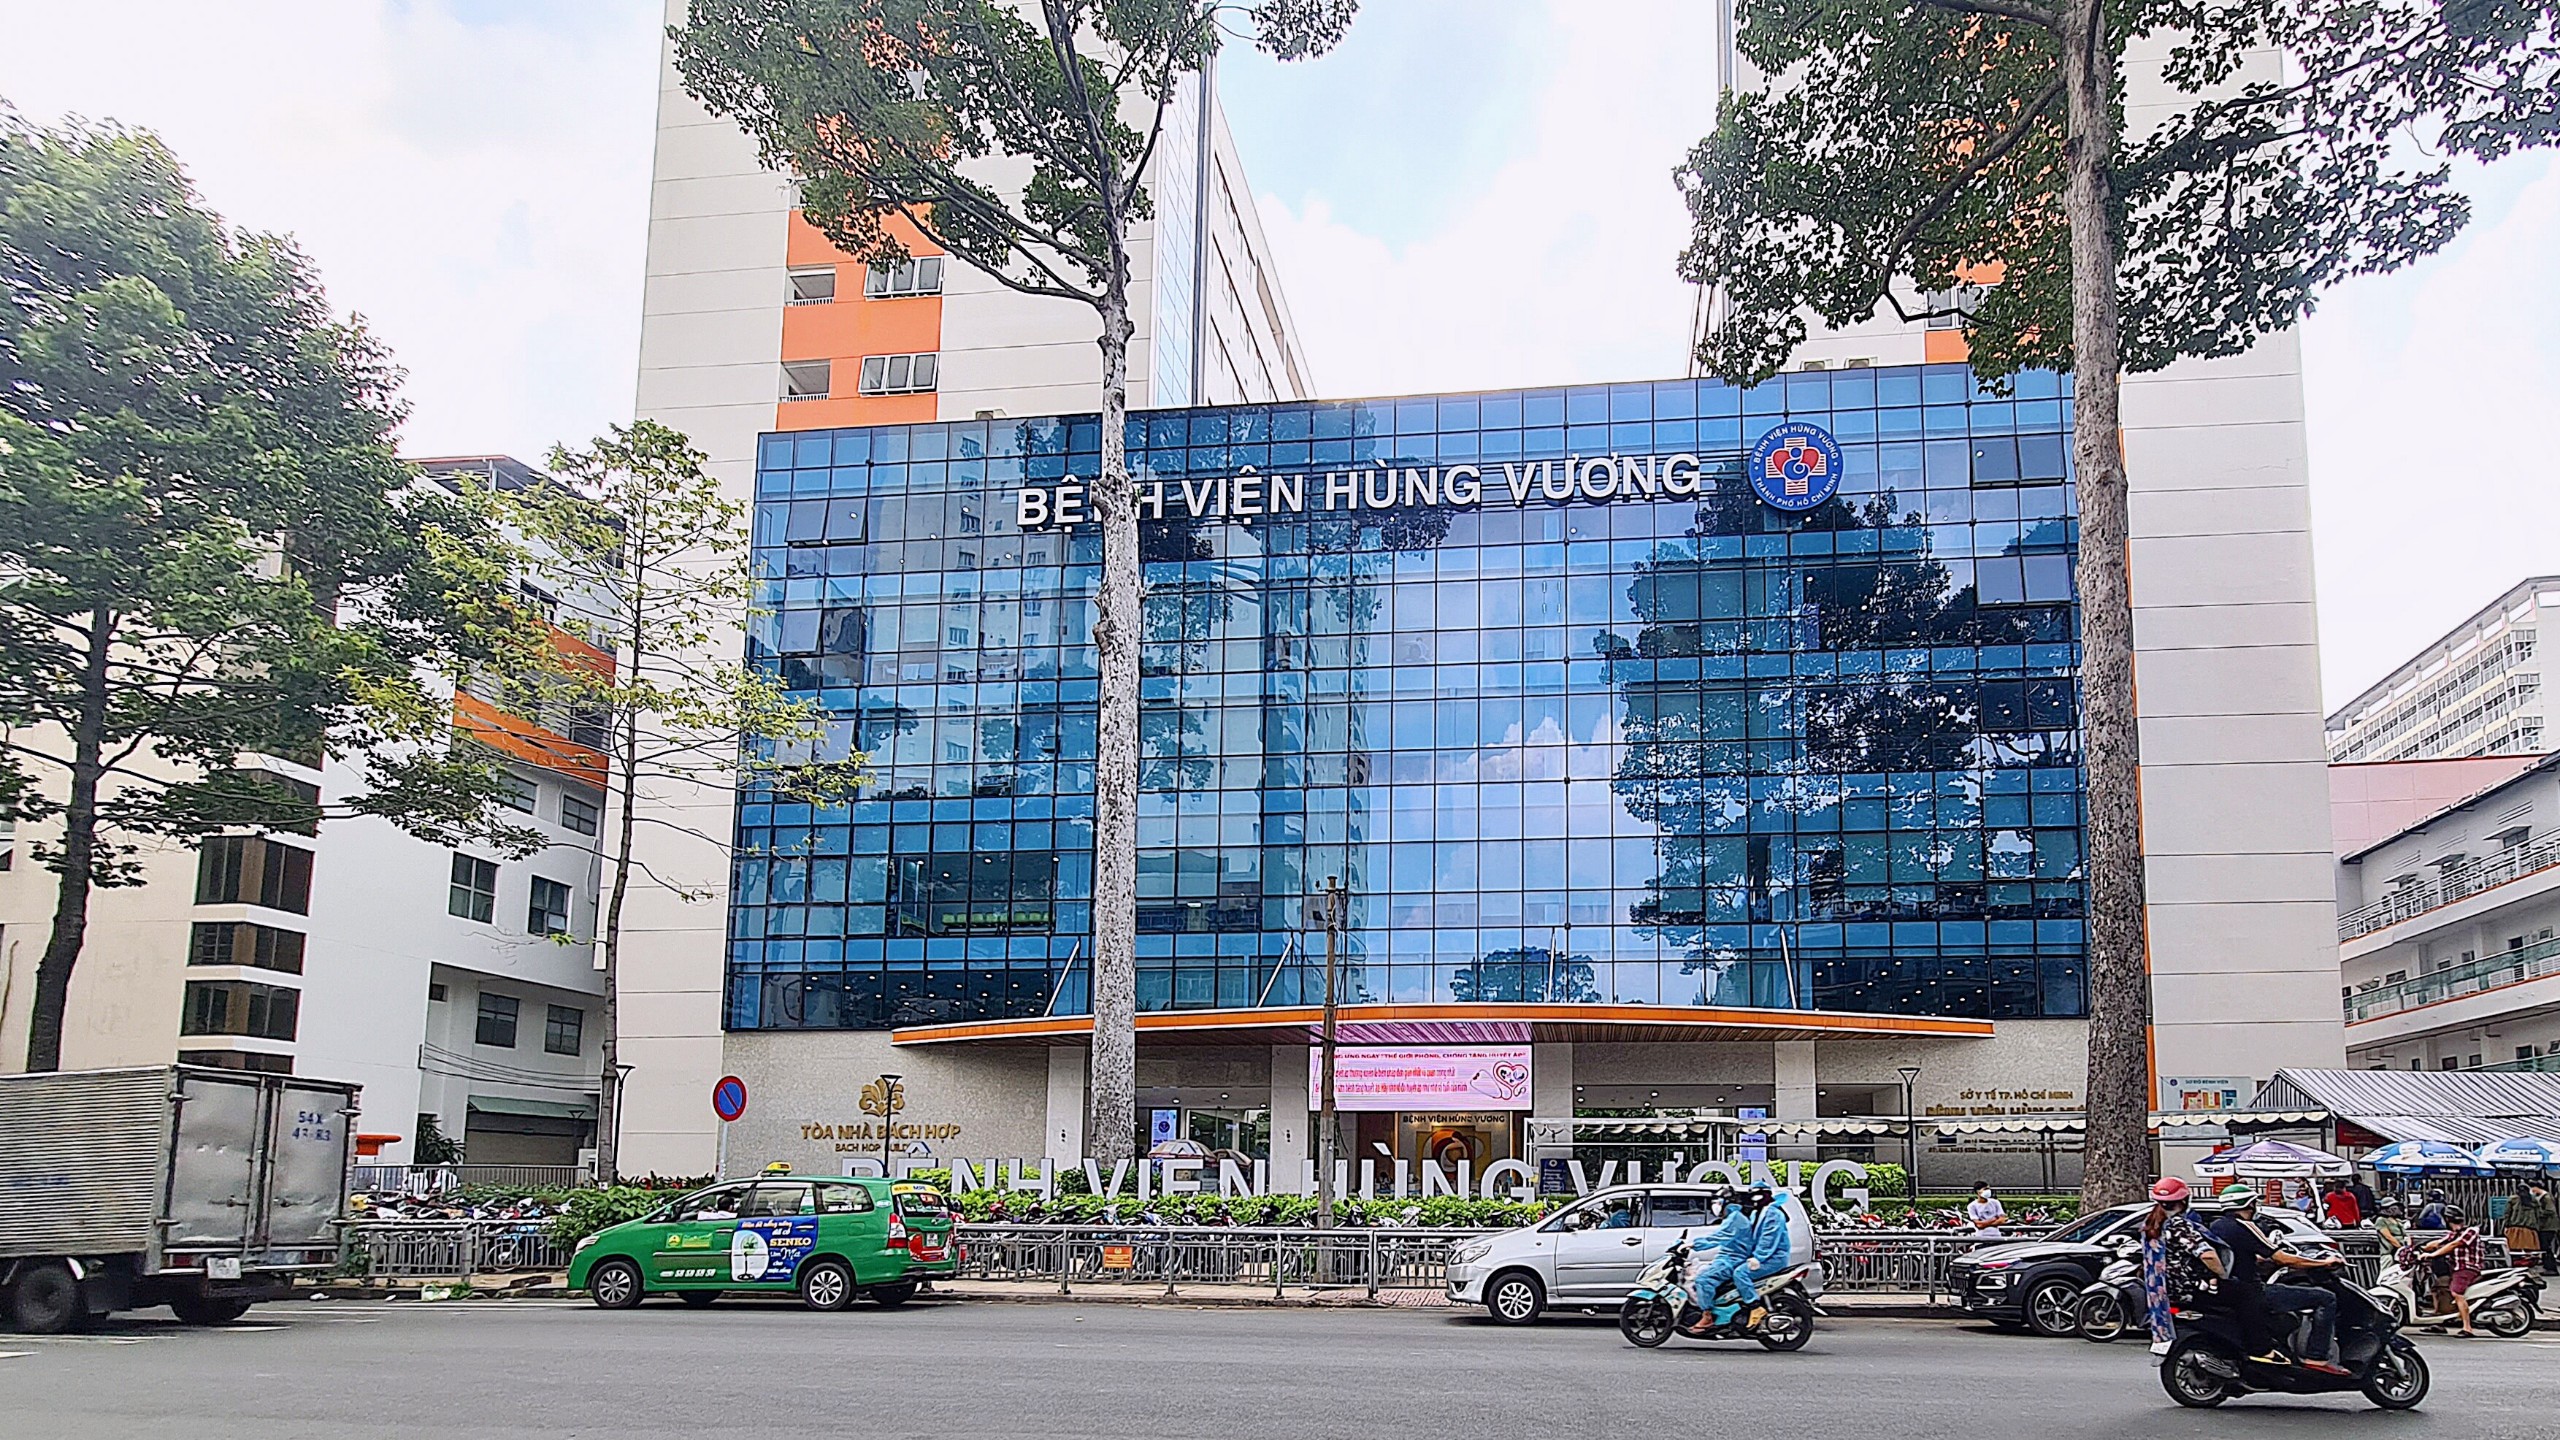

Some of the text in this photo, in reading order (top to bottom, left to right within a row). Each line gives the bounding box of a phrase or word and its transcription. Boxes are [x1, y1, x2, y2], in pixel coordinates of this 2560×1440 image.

[1753, 440, 1770, 463] BỆNH
[1181, 465, 1303, 525] VIỆN
[1325, 459, 1482, 512] HÙNG
[1503, 451, 1702, 507] VƯƠNG
[1823, 473, 1838, 493] MINH
[801, 1121, 961, 1144] TÒA NHÀ BÁCH HỢP
[835, 1143, 859, 1152] BACH
[769, 1237, 812, 1247] SENKO
